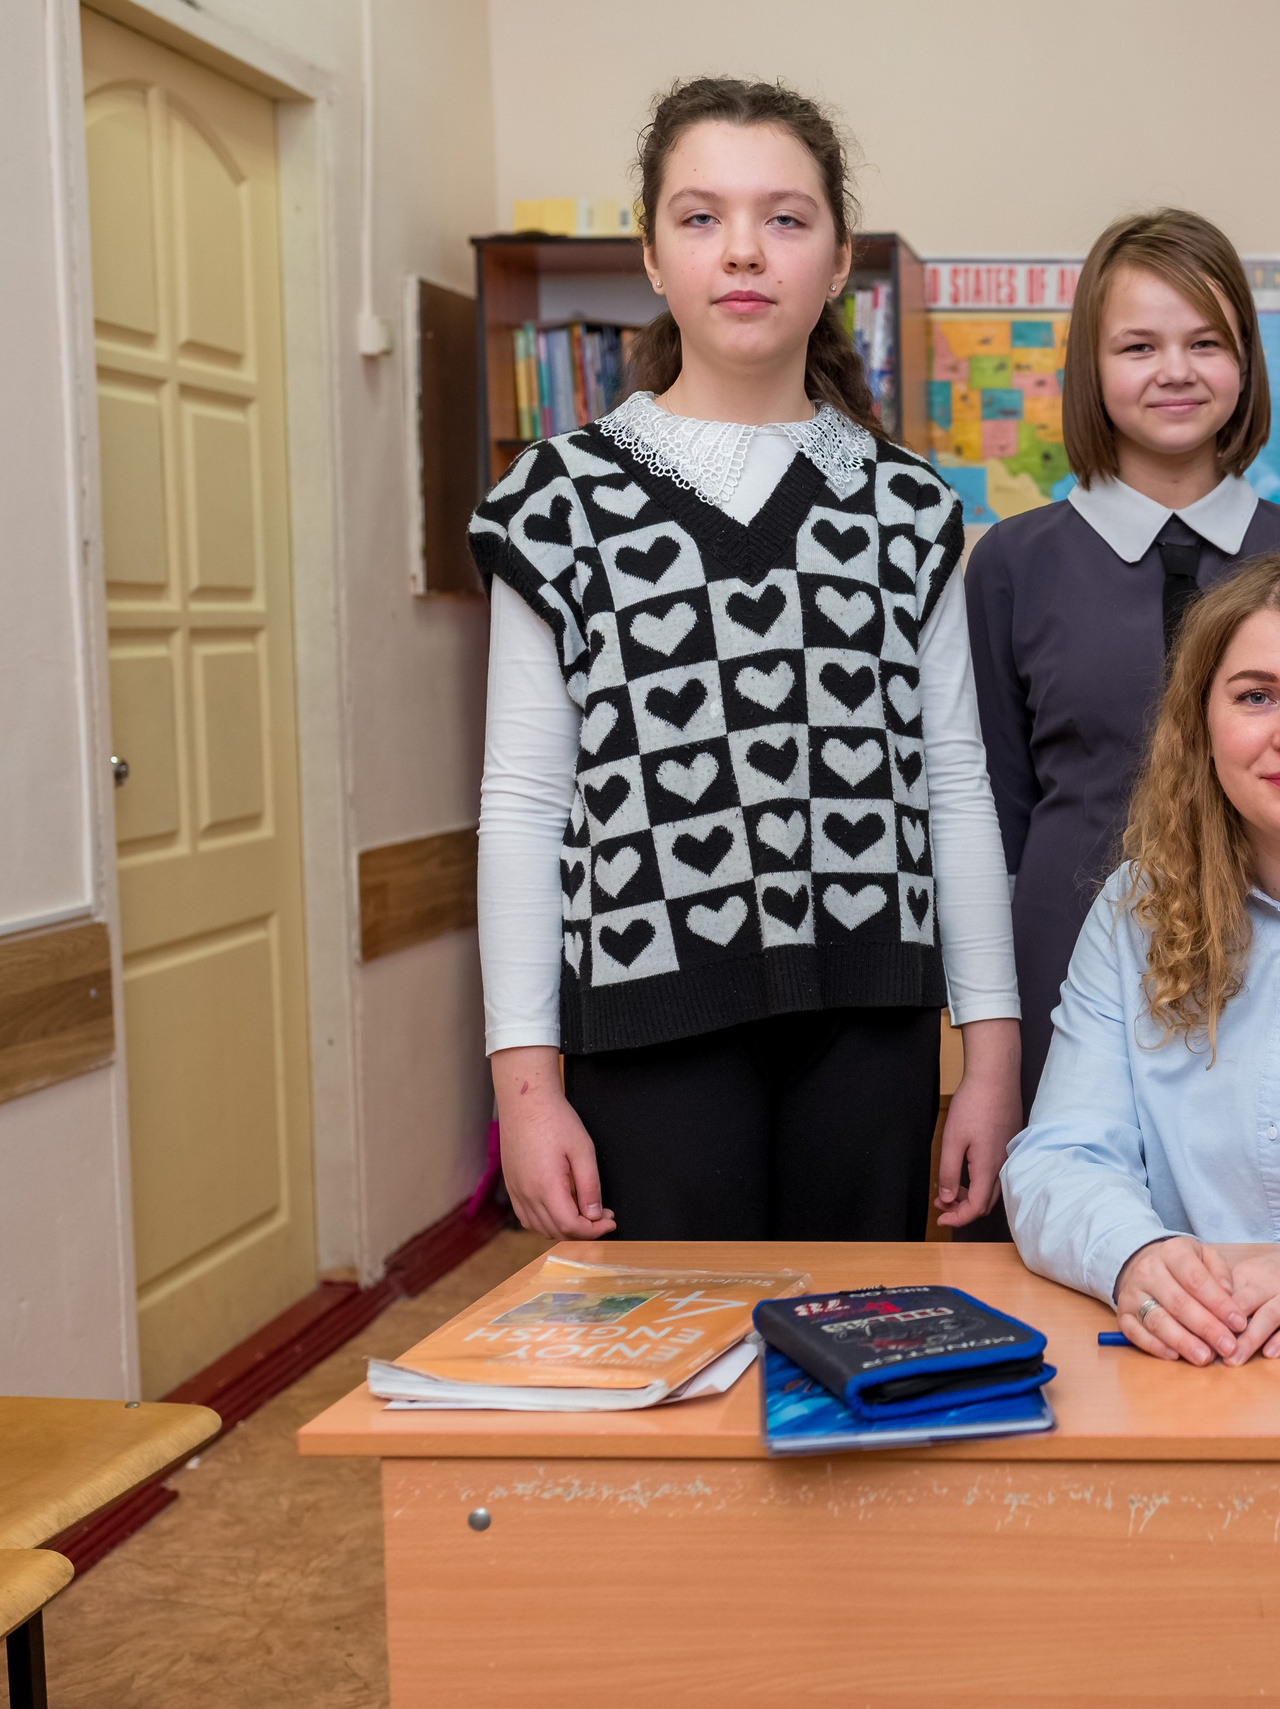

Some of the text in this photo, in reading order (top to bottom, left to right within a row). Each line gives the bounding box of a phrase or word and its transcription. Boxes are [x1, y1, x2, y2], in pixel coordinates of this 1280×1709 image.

[950, 267, 1017, 305] STATES
[1026, 266, 1045, 304] OF
[652, 1290, 748, 1324] 4
[462, 1325, 705, 1345] ENGLISH
[497, 1342, 685, 1362] ENJOY
